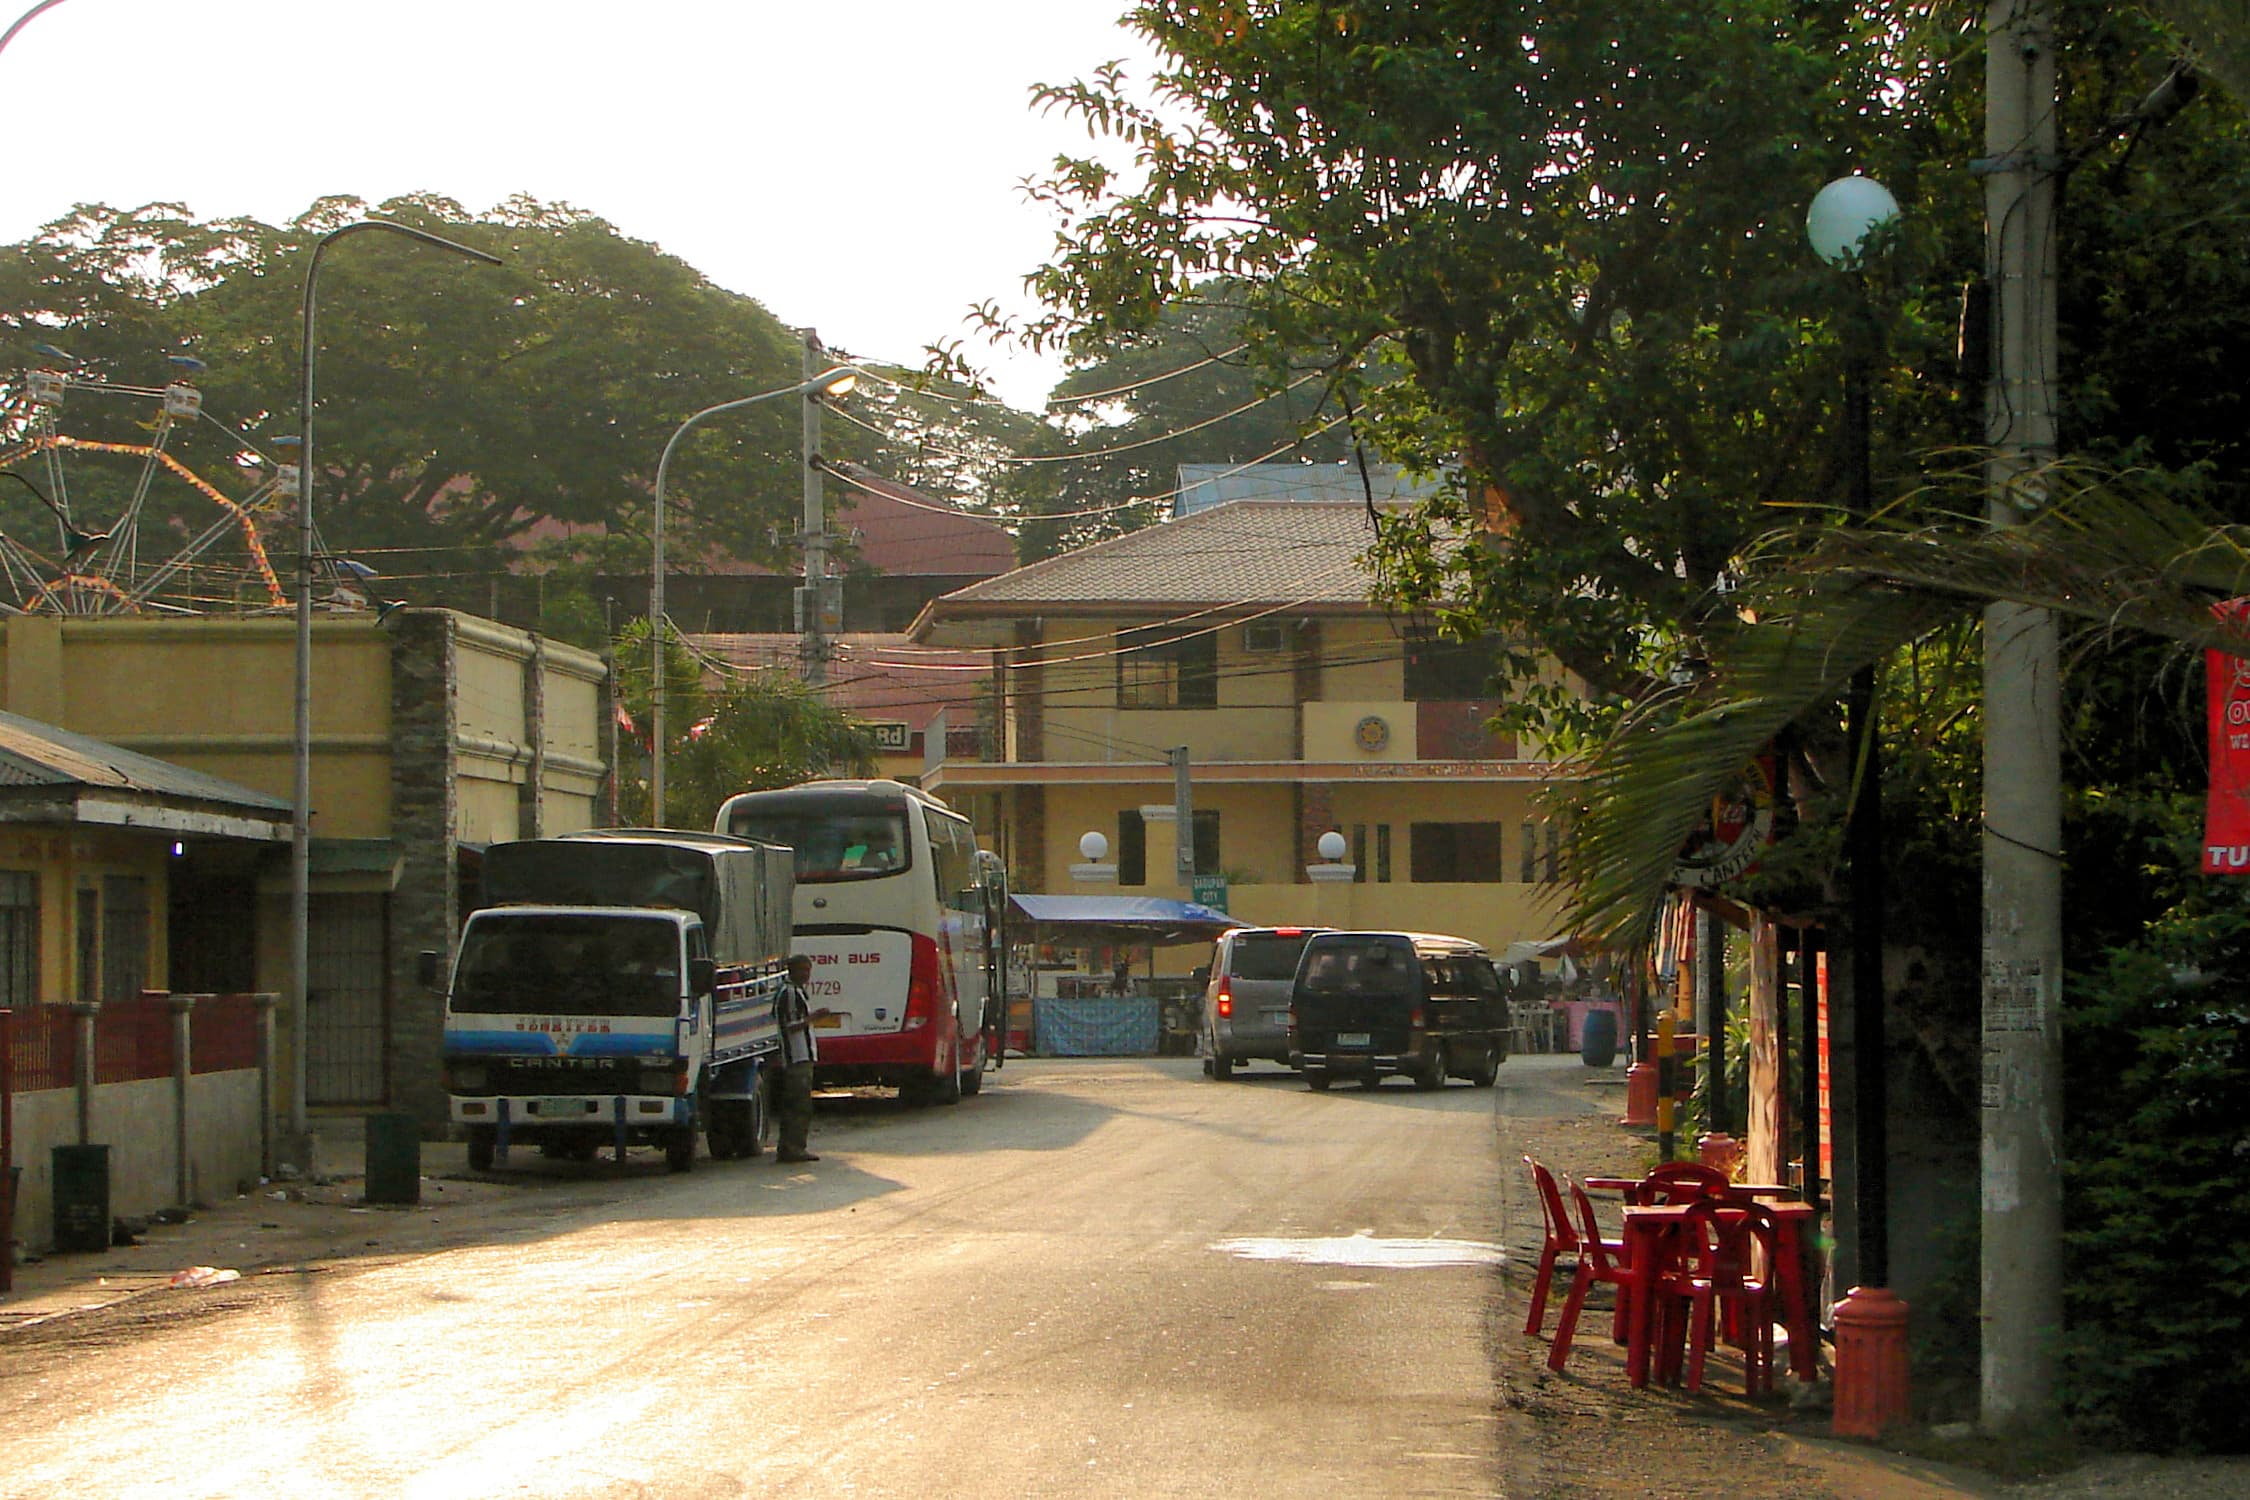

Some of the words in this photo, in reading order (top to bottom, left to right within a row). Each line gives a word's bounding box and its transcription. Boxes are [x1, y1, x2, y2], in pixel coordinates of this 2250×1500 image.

[876, 727, 902, 745] Rd
[848, 952, 881, 964] BUS
[510, 1058, 614, 1069] CANTER
